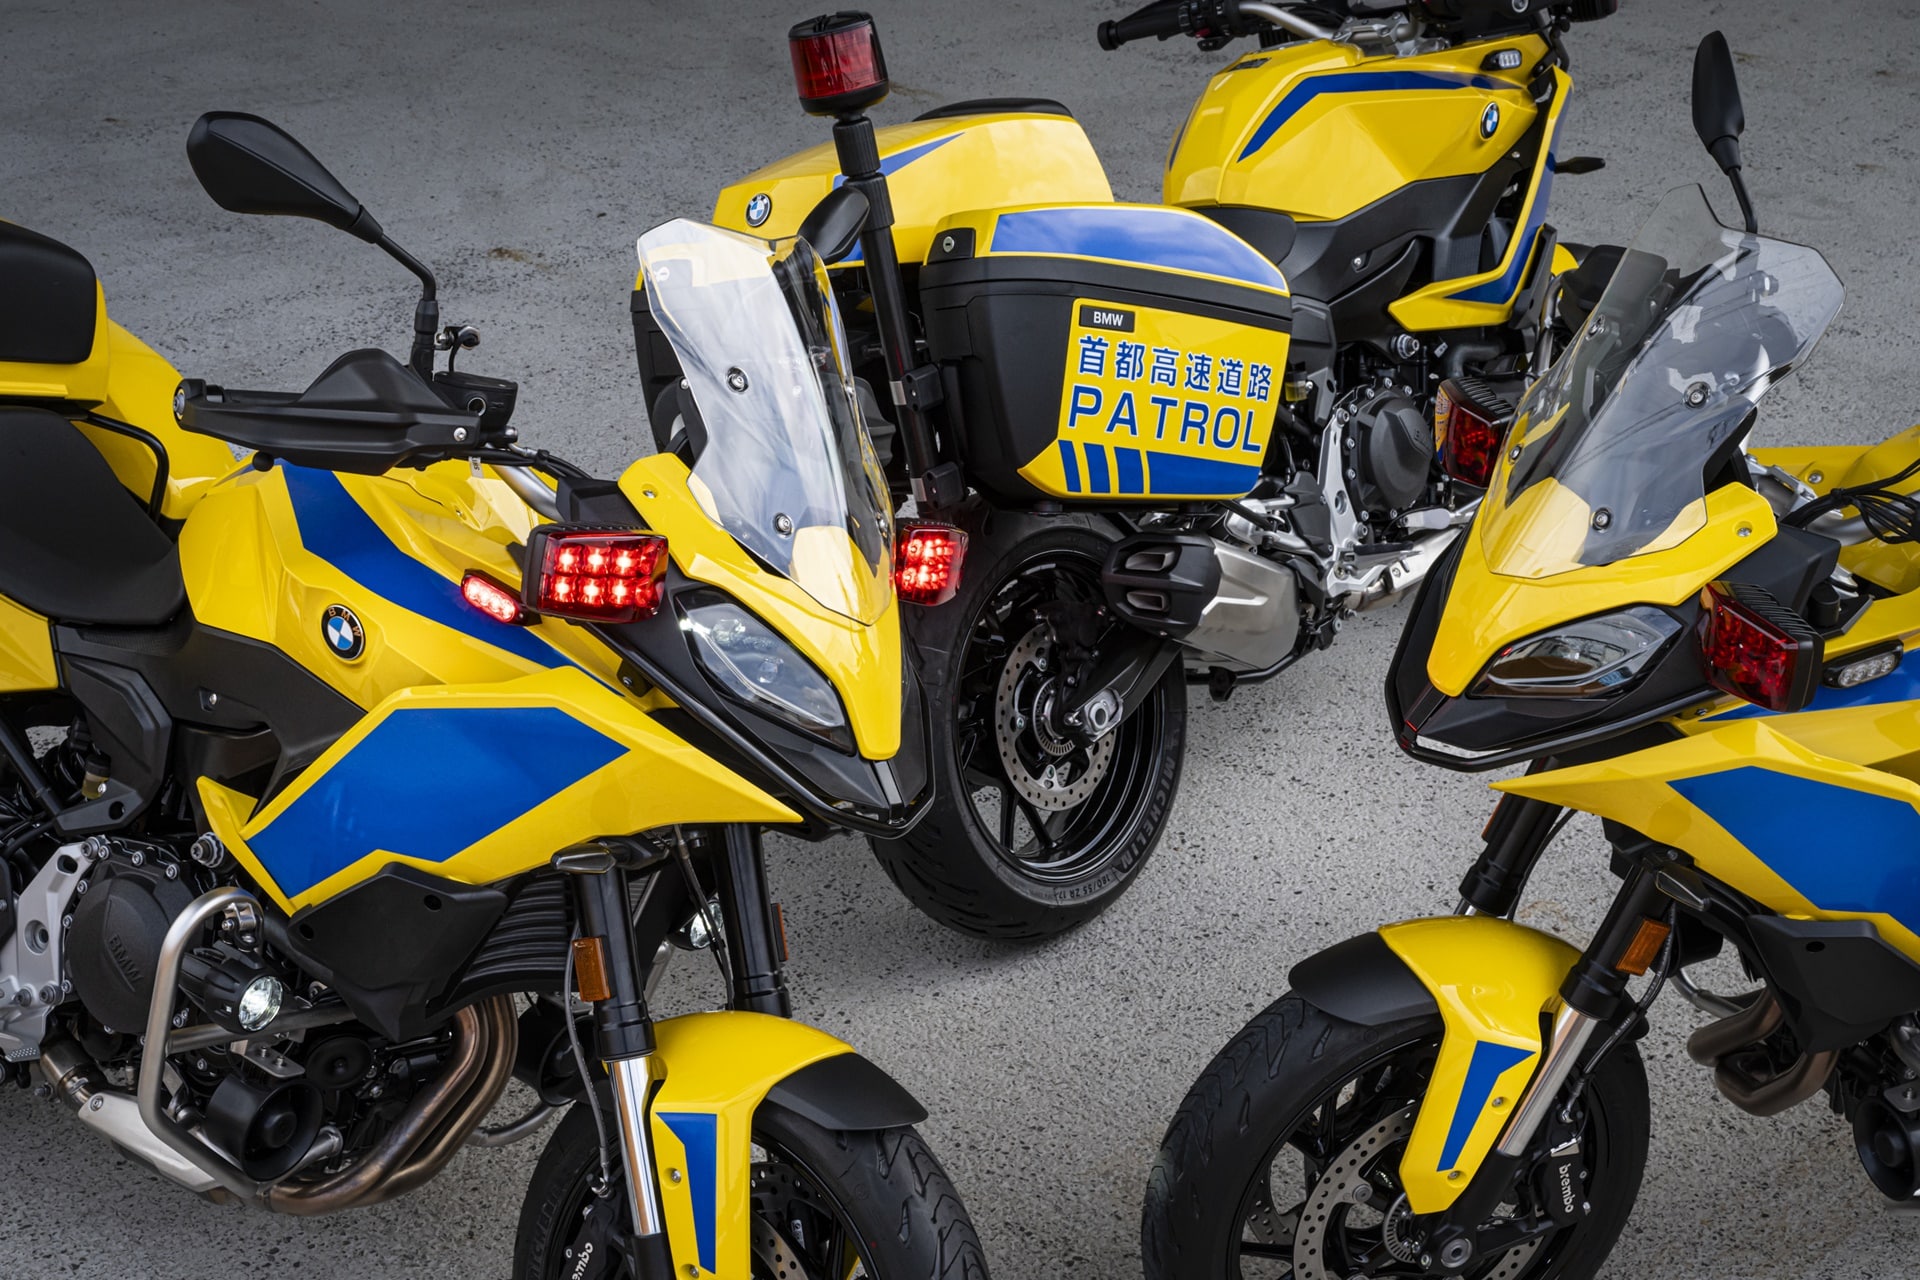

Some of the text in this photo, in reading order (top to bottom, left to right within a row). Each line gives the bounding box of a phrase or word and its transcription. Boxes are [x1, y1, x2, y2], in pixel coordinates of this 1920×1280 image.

[1093, 311, 1124, 327] BMW
[1078, 335, 1272, 402] 首都高速道路
[1067, 385, 1262, 452] PATROL
[327, 606, 362, 637] BMW
[1121, 756, 1176, 870] MICHELIN
[109, 933, 145, 983] BMW
[1558, 1163, 1576, 1214] brembo
[571, 1242, 594, 1280] embo
